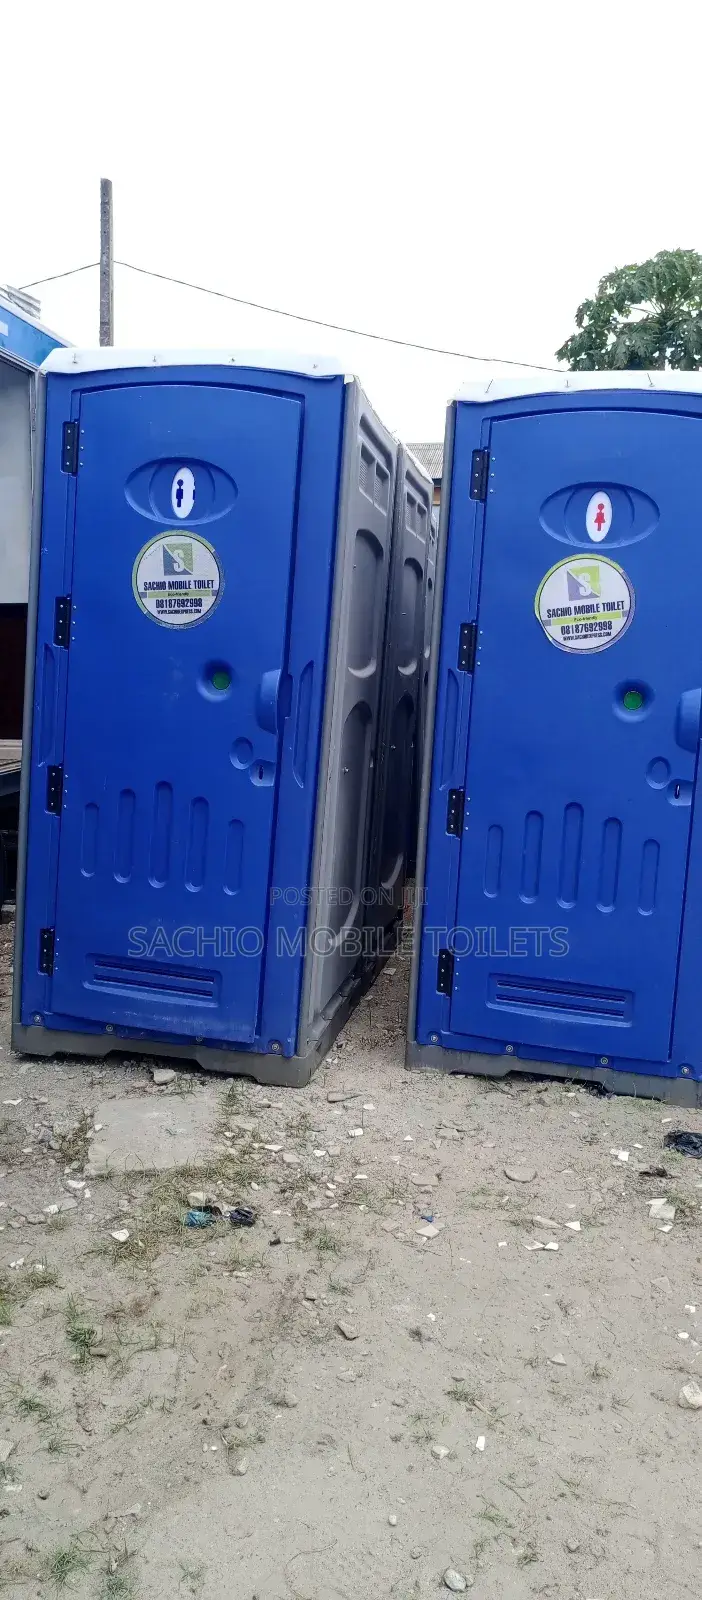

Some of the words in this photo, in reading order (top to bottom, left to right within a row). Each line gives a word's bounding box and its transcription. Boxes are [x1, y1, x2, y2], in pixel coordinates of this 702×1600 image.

[173, 549, 185, 572] S
[144, 581, 166, 591] SACHIO
[168, 580, 191, 590] MOBILE
[194, 579, 214, 589] TOILET
[579, 573, 592, 596] S
[155, 598, 203, 609] 08187692998
[547, 607, 572, 618] SACHIO
[573, 603, 600, 616] MOBILE
[602, 601, 624, 612] TOILET
[561, 621, 612, 635] 08187692998
